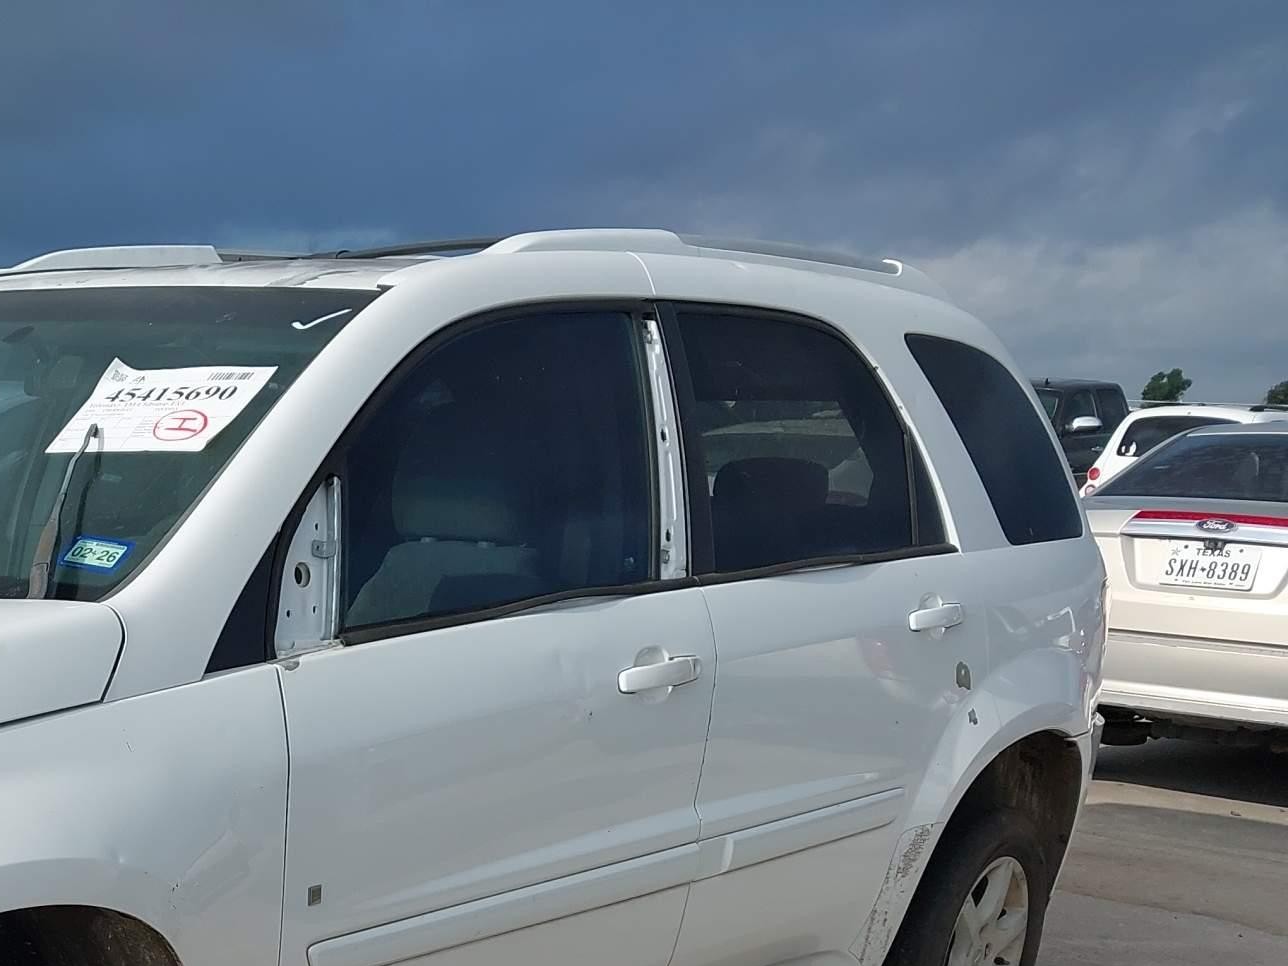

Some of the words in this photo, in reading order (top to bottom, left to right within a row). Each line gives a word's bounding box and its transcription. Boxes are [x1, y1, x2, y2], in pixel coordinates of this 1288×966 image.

[104, 385, 238, 403] 45415690
[1202, 519, 1230, 532] Ford
[1196, 548, 1231, 558] TEXAS
